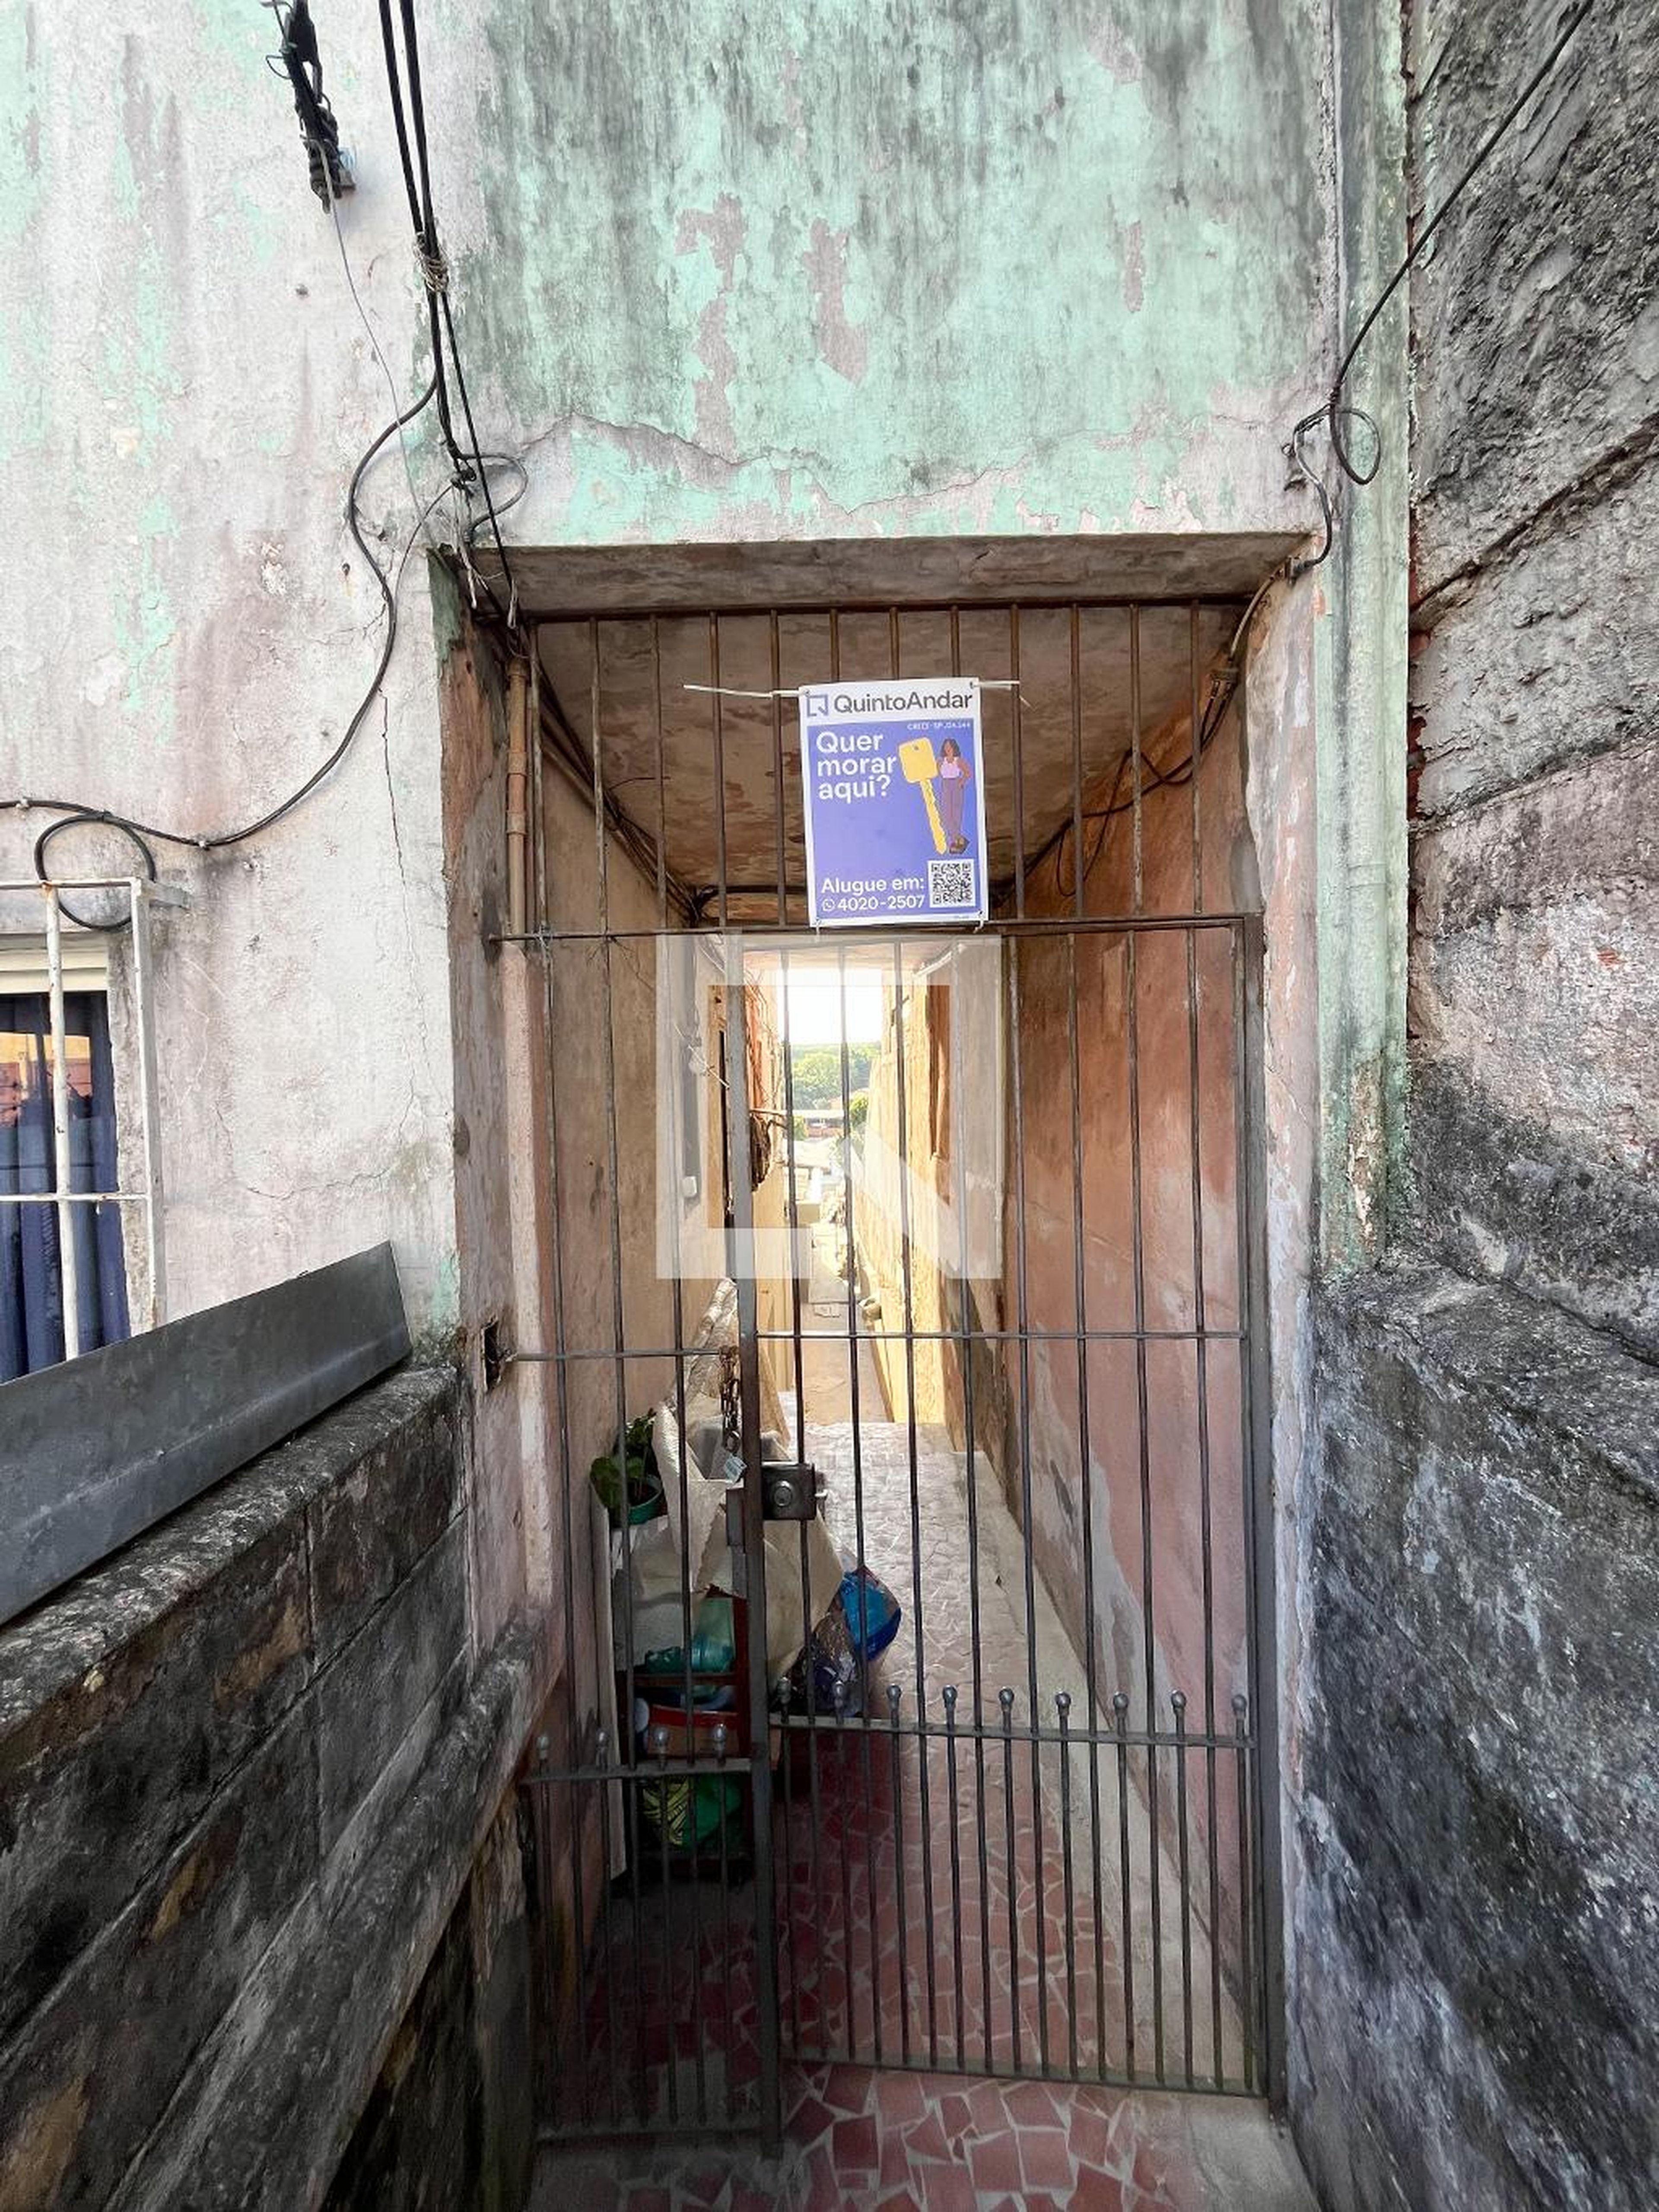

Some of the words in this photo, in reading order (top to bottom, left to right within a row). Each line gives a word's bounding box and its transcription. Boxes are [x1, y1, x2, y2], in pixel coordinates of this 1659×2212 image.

[834, 691, 973, 713] QuintoAndar
[816, 731, 883, 753] Quer
[817, 754, 896, 777] morar
[818, 774, 890, 803] aqui?
[822, 877, 887, 896] Alugue
[892, 878, 925, 891] em:
[837, 895, 925, 911] 4020-2507
